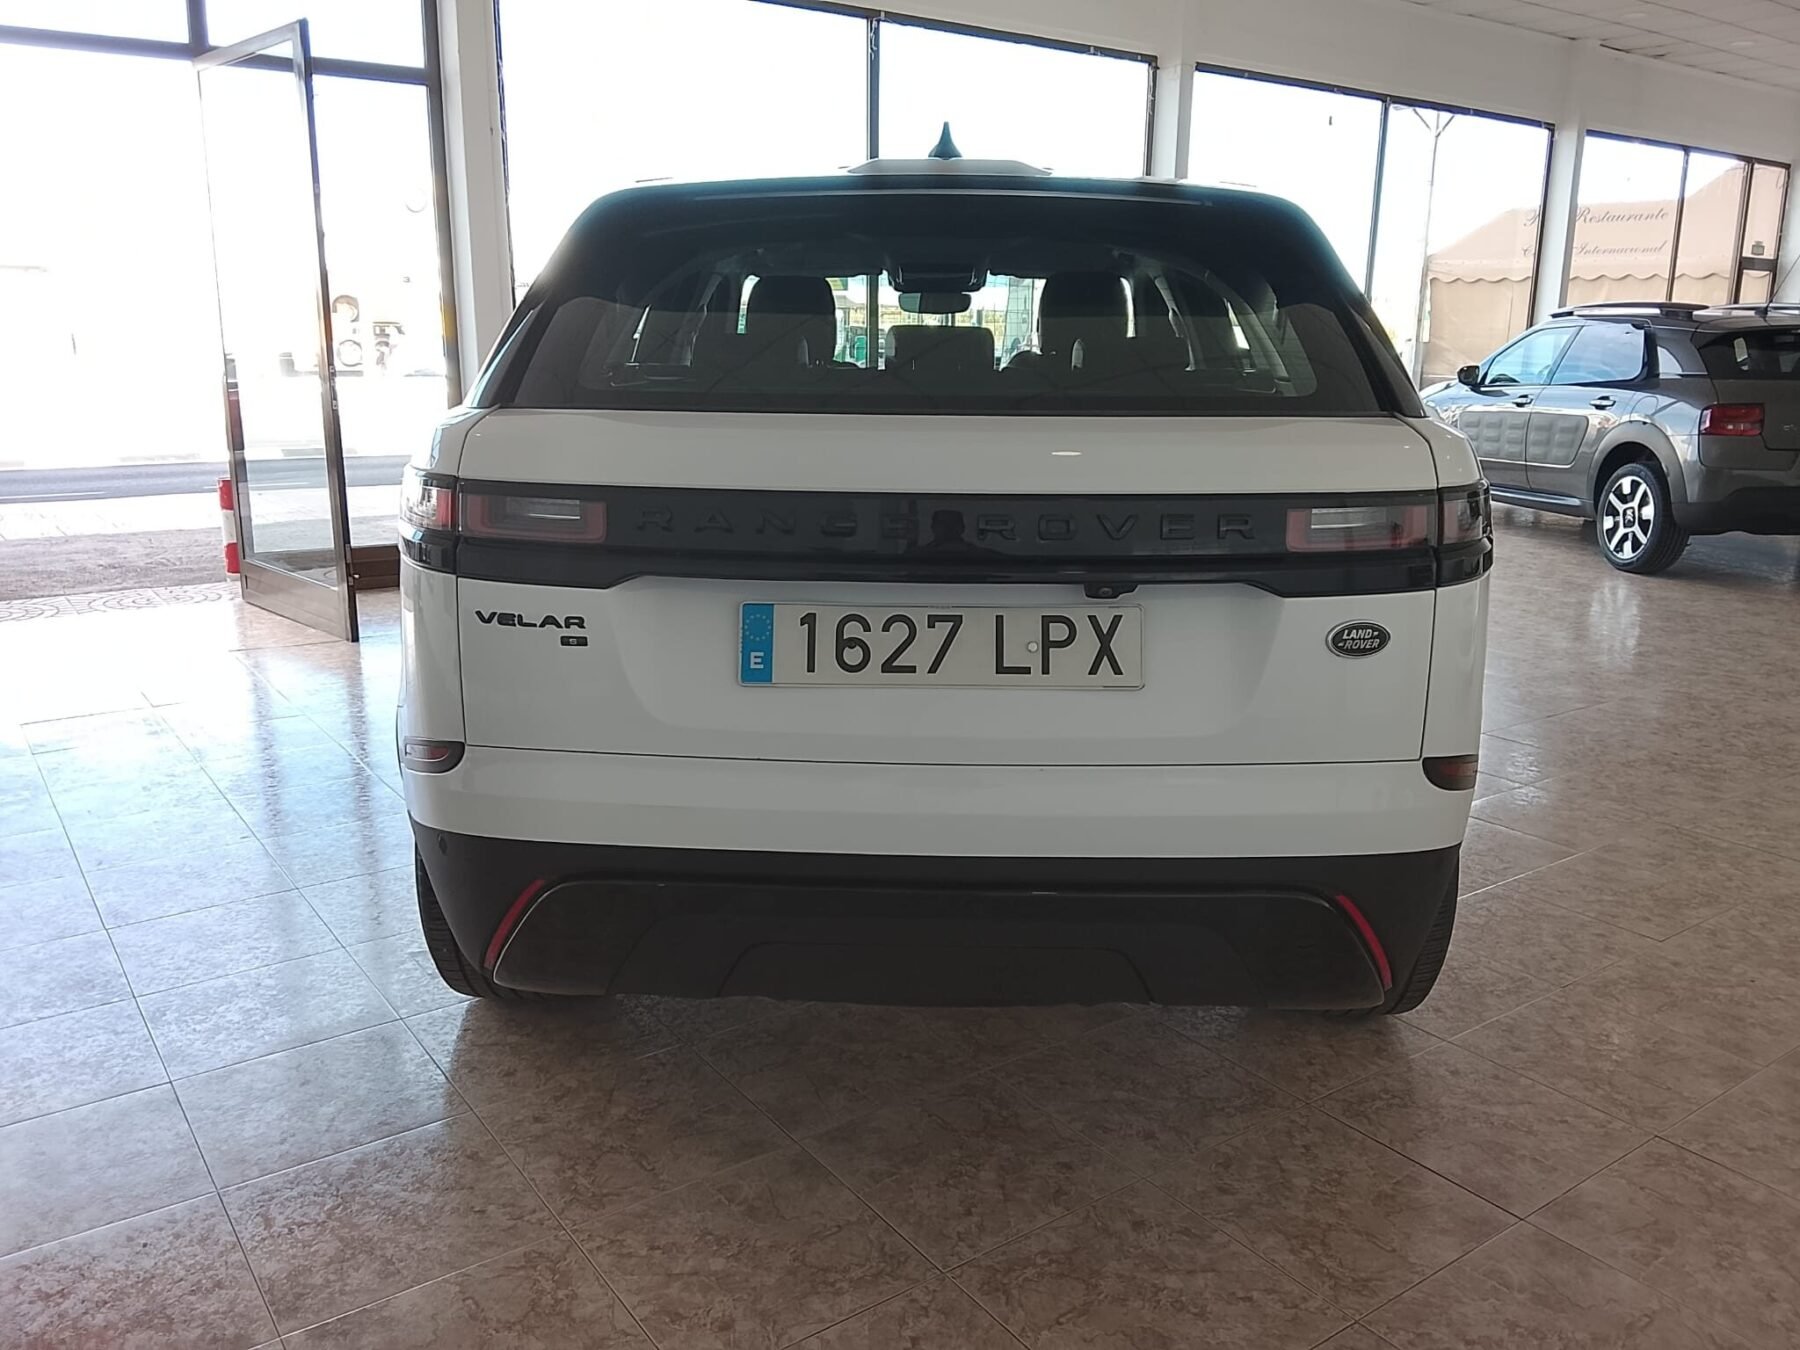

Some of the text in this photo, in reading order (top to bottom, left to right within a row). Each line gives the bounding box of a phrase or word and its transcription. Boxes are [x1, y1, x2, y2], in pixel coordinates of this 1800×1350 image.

[1576, 207, 1669, 224] Restaurante
[1574, 240, 1668, 256] Internacional
[635, 507, 1256, 542] RANGE ROVER
[475, 610, 586, 629] VELAR
[1342, 629, 1373, 639] LAND
[799, 612, 1124, 676] 1627 LPX
[1343, 639, 1380, 649] ROVER
[749, 651, 765, 669] E
